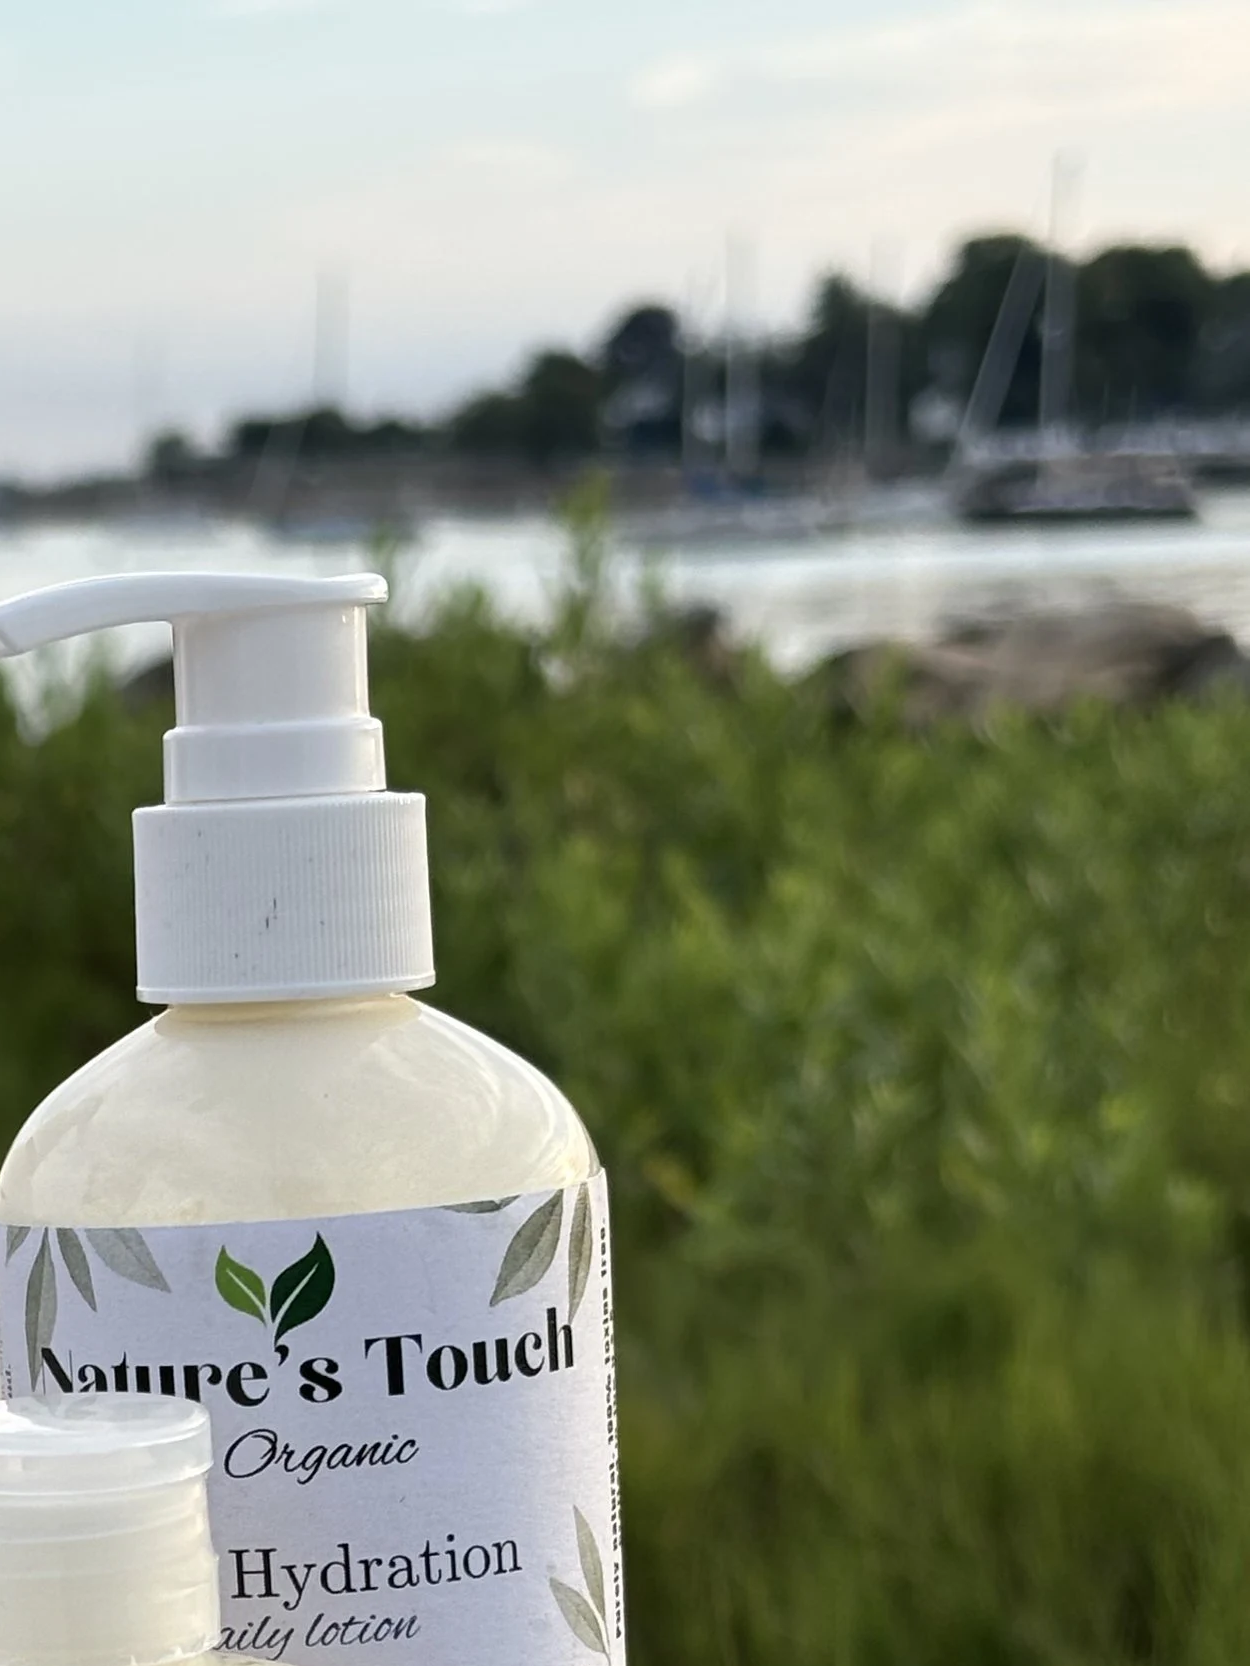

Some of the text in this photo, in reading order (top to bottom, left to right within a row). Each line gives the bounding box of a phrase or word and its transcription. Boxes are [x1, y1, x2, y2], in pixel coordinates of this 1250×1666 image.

[40, 1343, 344, 1408] Nature's
[364, 1306, 575, 1397] Touch
[222, 1427, 419, 1485] Organic
[227, 1534, 522, 1611] Hydration
[212, 1612, 422, 1661] aily lotion
